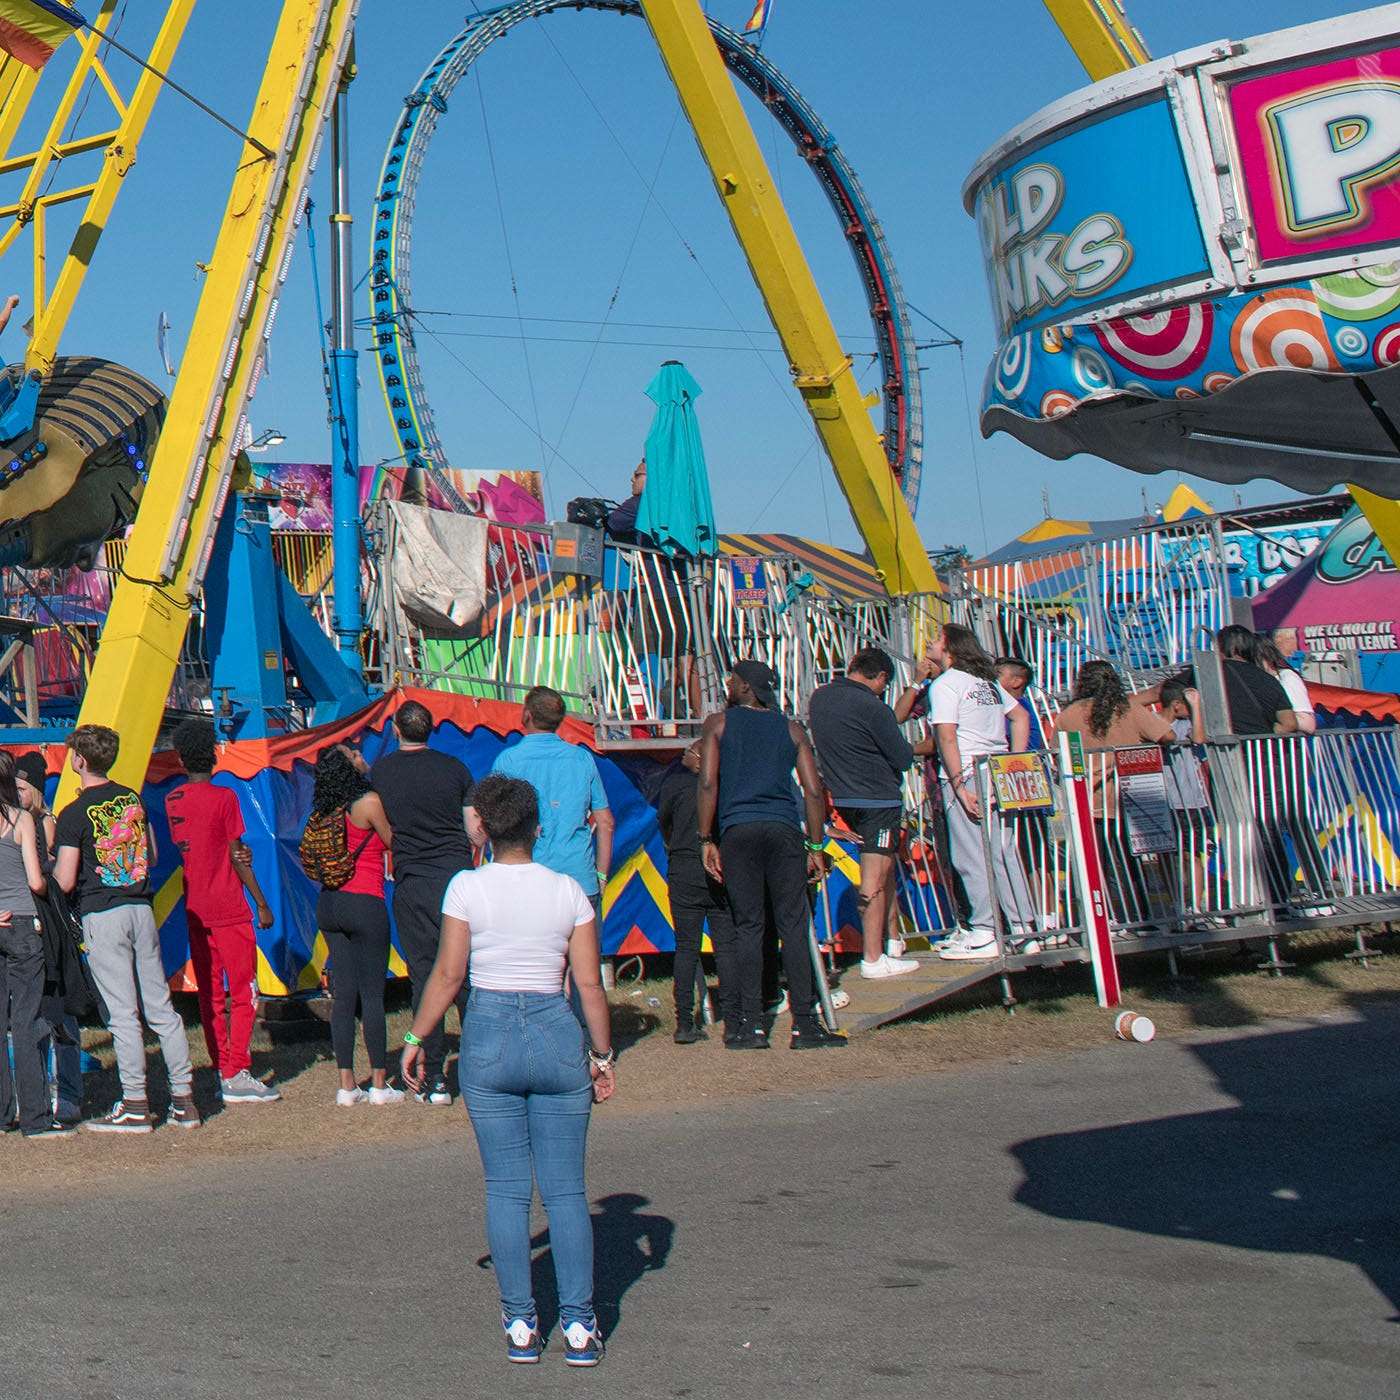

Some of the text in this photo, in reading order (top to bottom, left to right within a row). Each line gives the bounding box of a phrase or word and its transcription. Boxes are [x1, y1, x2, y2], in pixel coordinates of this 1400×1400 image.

[744, 573, 754, 589] 5
[735, 589, 766, 600] TICKETS
[1304, 621, 1395, 638] WE'LL HOLD IT
[1330, 637, 1357, 650] YOU
[1358, 633, 1398, 650] LEAVE
[976, 682, 990, 692] THE
[966, 689, 993, 702] NORTH
[977, 697, 995, 707] FACE
[1118, 749, 1158, 764] SAFETY
[996, 770, 1047, 802] ENTER
